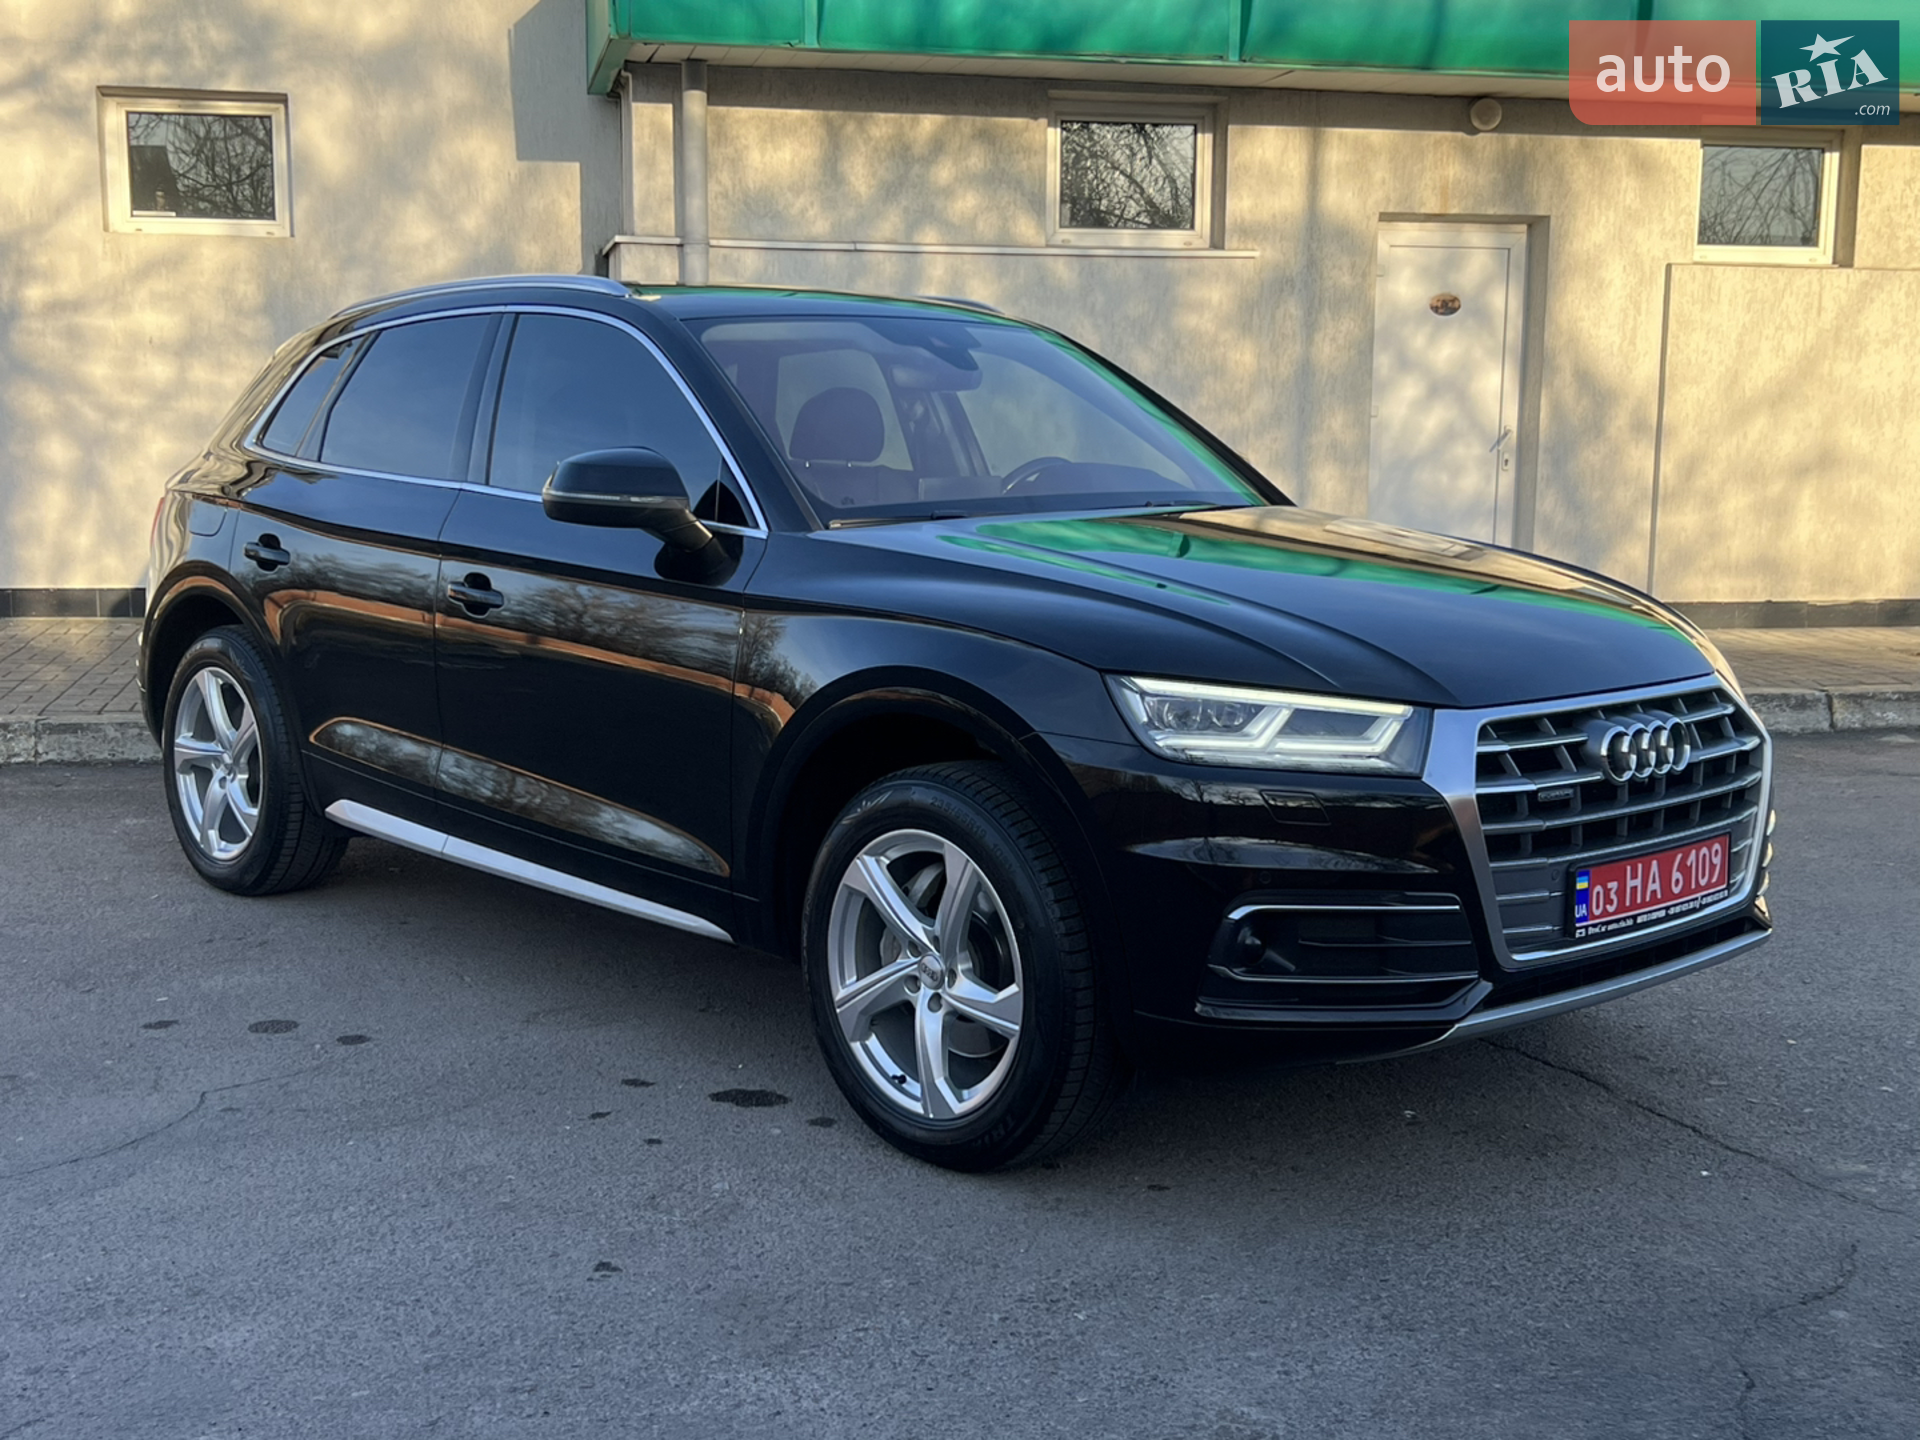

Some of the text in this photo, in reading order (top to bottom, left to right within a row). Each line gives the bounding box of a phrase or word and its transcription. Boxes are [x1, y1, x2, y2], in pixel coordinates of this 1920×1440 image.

[1592, 880, 1618, 917] 03
[1625, 859, 1662, 907] HA
[1671, 842, 1722, 895] 6109
[1575, 904, 1588, 918] UA
